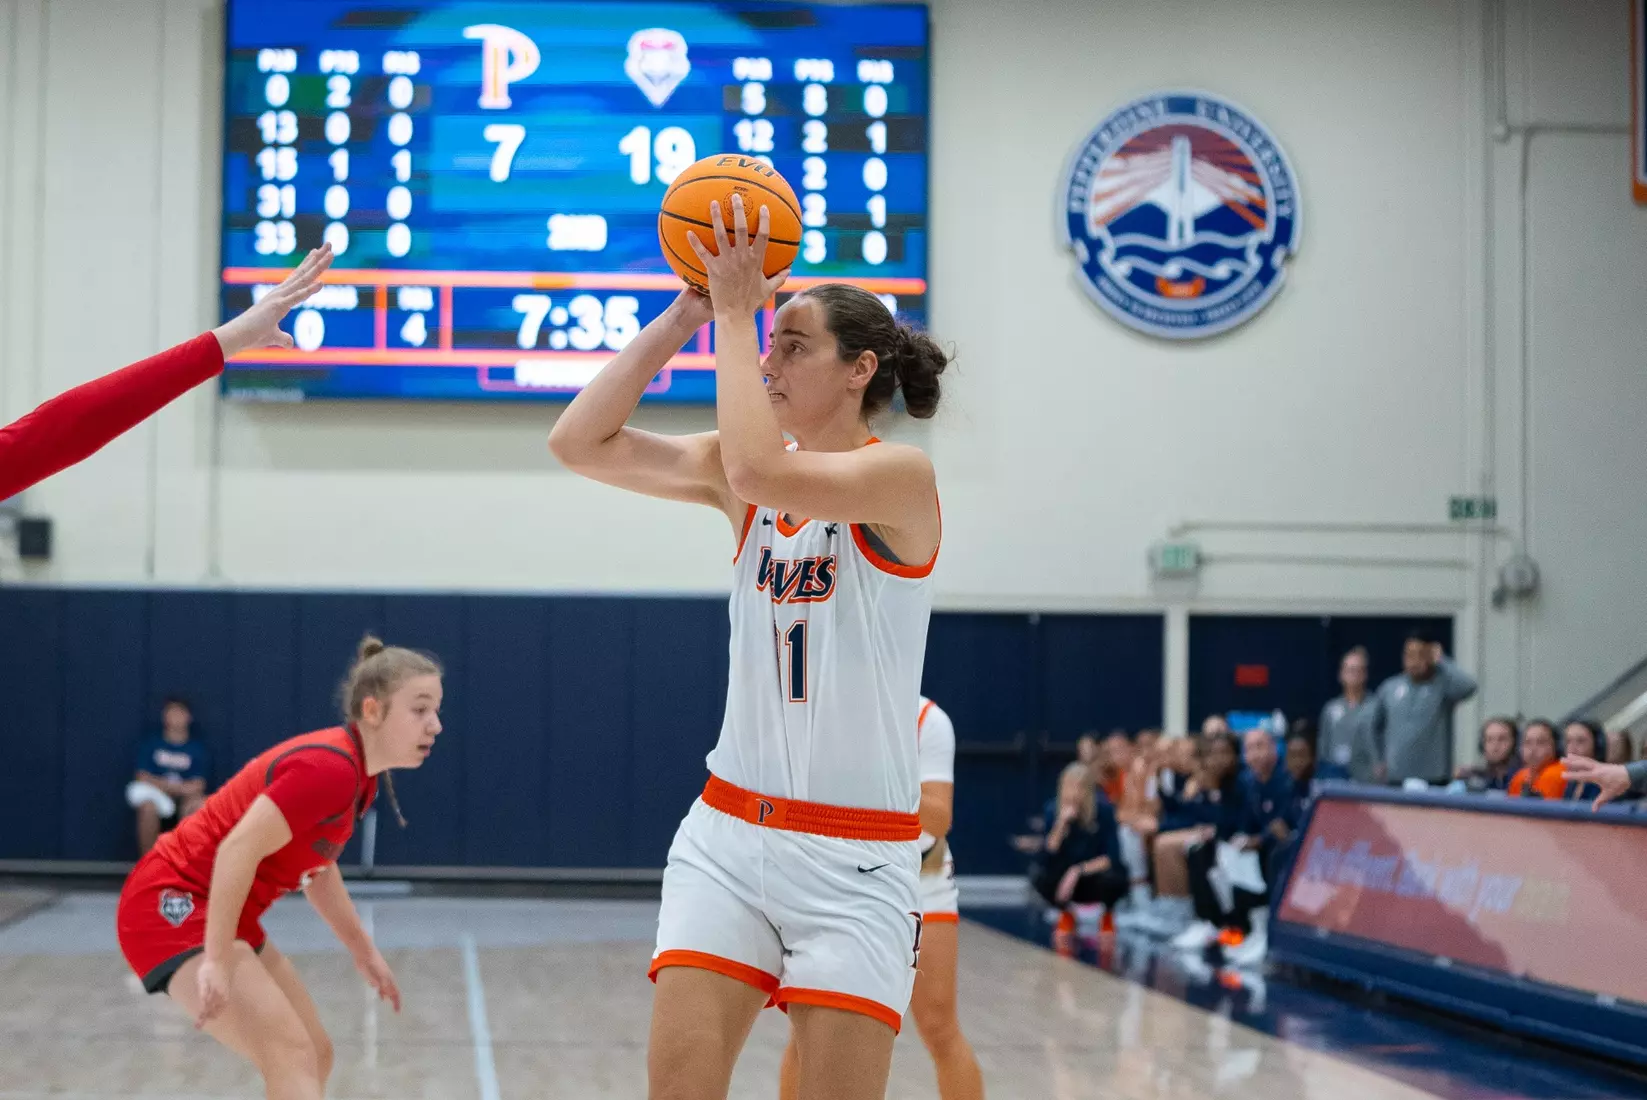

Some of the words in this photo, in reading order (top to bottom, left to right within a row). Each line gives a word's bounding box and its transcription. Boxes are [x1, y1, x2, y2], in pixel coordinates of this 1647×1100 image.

[463, 24, 541, 109] P
[266, 74, 290, 106] 0
[327, 75, 351, 107] 2
[389, 76, 414, 109] 0
[864, 85, 888, 117] 0
[258, 111, 298, 144] 13
[326, 112, 350, 144] 0
[388, 112, 413, 145] 0
[867, 122, 886, 153] 1
[329, 148, 349, 181] 1
[391, 149, 411, 182] 1
[484, 124, 526, 182] 7
[619, 126, 696, 185] 19
[863, 157, 888, 191] 0
[258, 184, 296, 218] 31
[324, 185, 349, 219] 0
[387, 186, 412, 219] 0
[866, 194, 886, 227] 1
[255, 221, 296, 255] 33
[387, 222, 411, 257] 0
[863, 231, 888, 265] 0
[294, 309, 325, 351] 0
[400, 312, 428, 346] 4
[512, 293, 641, 351] 7:35
[774, 619, 808, 703] 1
[756, 798, 775, 823] P
